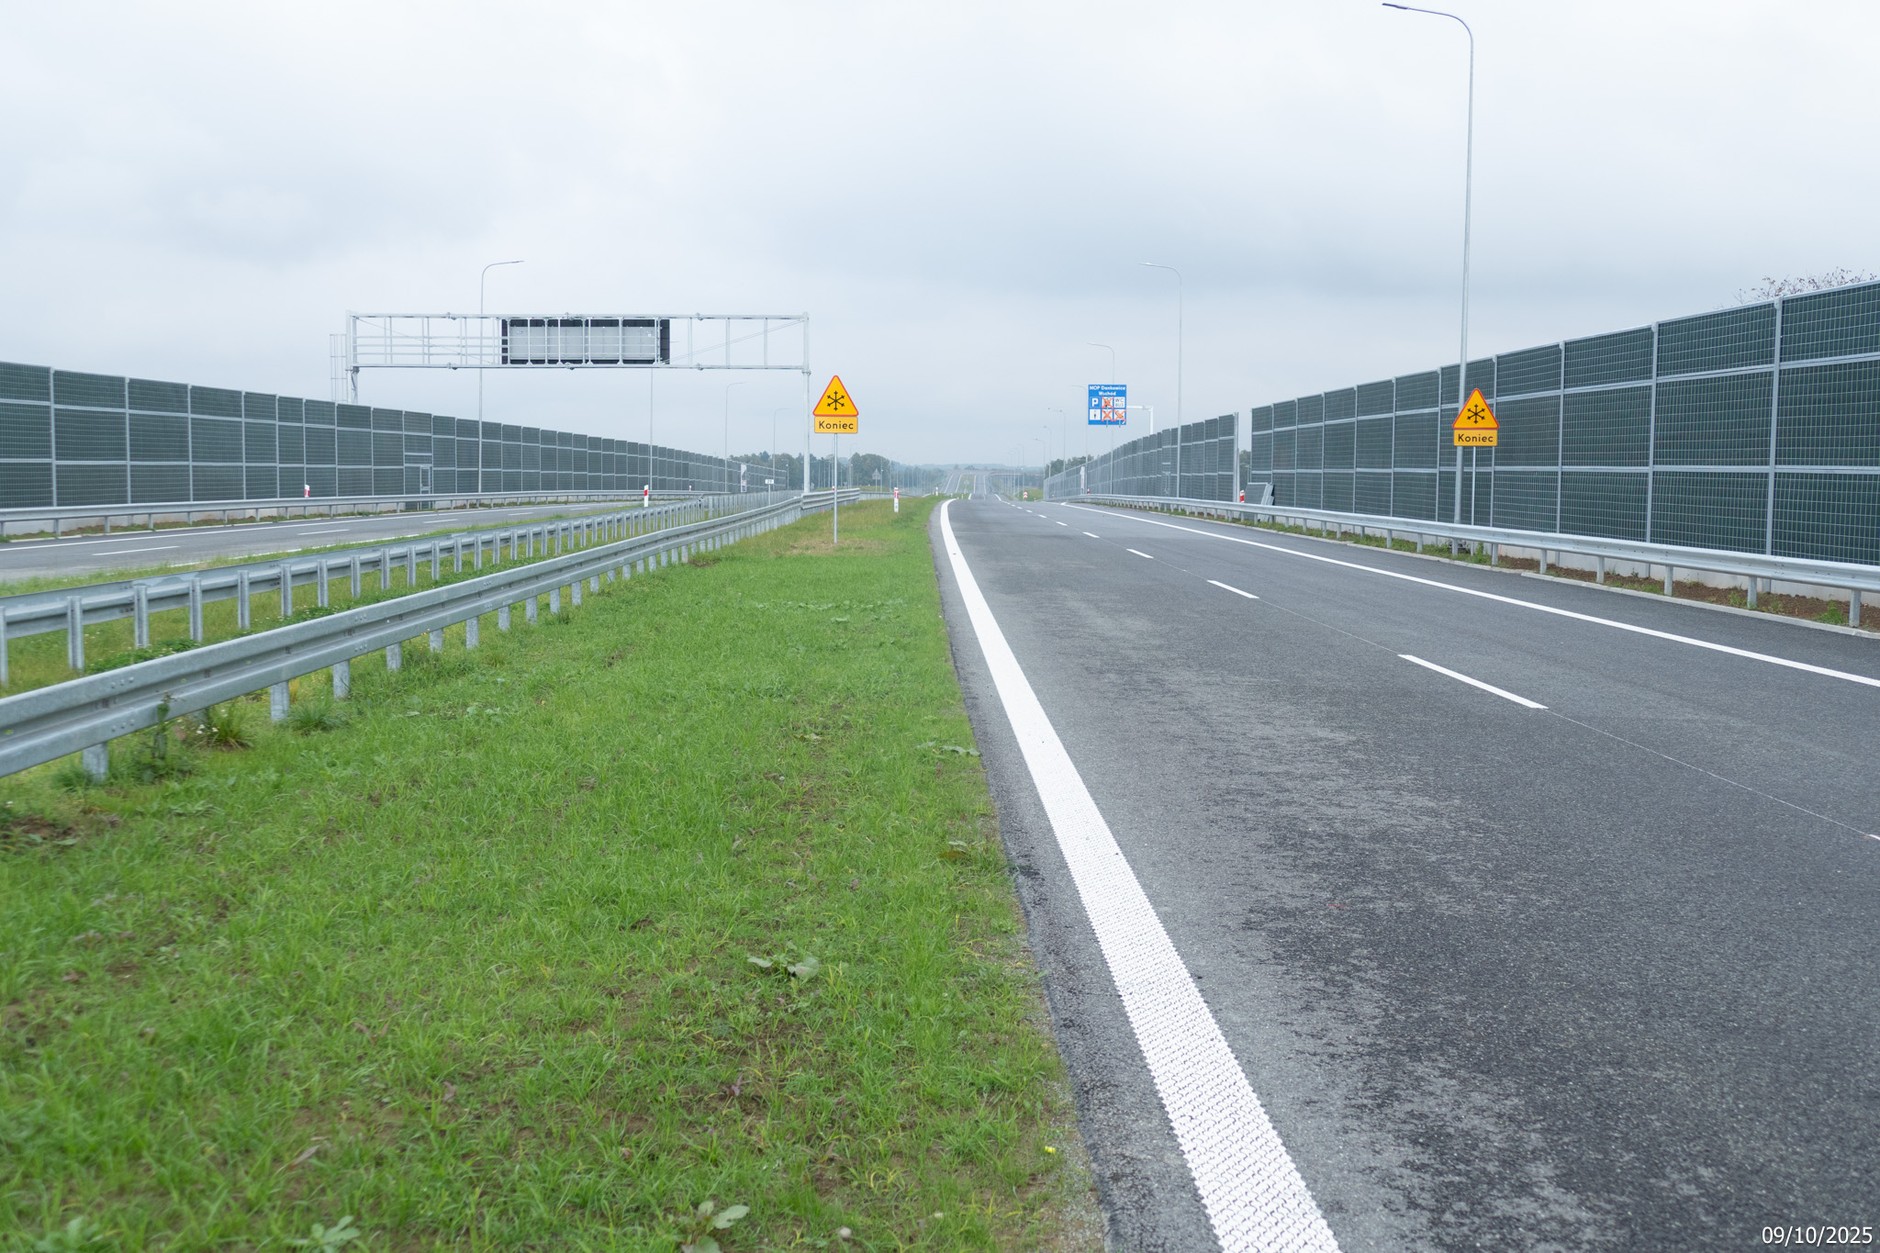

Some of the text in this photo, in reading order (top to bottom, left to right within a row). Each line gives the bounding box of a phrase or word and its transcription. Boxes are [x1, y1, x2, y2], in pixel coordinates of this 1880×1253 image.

[1091, 398, 1099, 407] P
[818, 420, 854, 429] Koniec
[1457, 433, 1494, 442] Koniec
